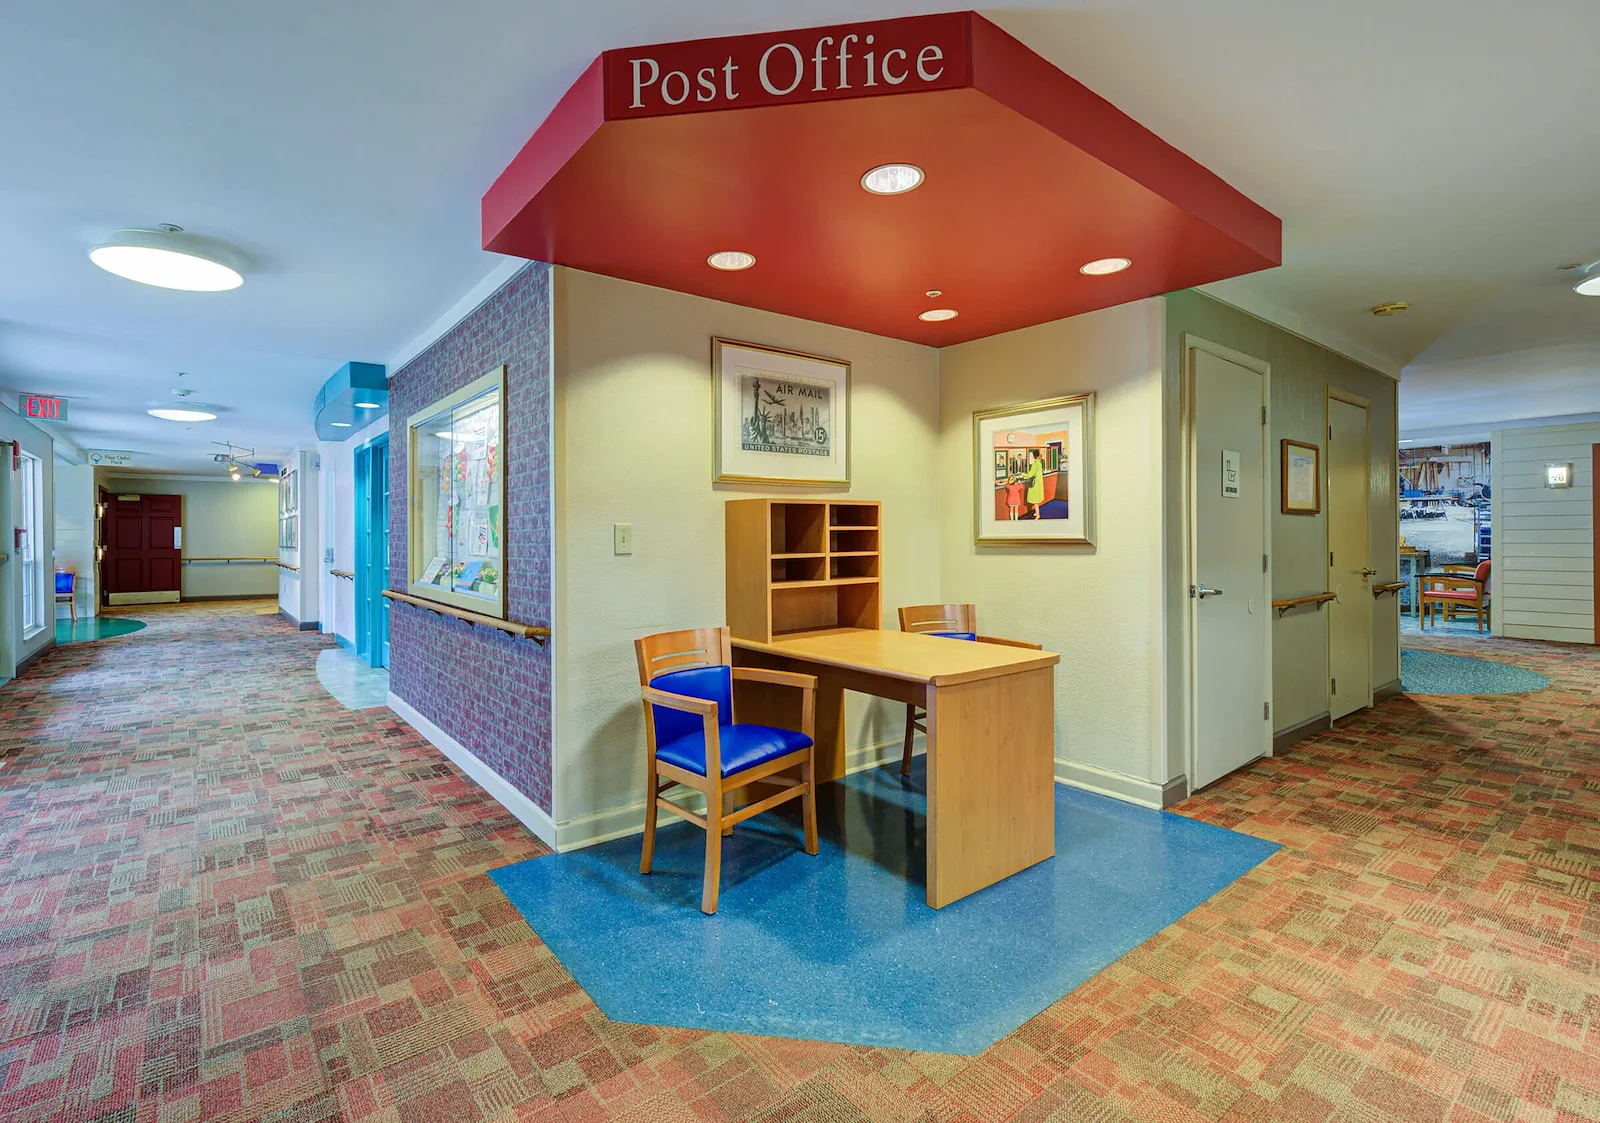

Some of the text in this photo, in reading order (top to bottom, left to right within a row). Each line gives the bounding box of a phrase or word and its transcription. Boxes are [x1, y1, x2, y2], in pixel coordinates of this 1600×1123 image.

[628, 34, 944, 109] Post Office
[776, 384, 822, 399] AIR MAIL
[28, 396, 62, 418] EXIT
